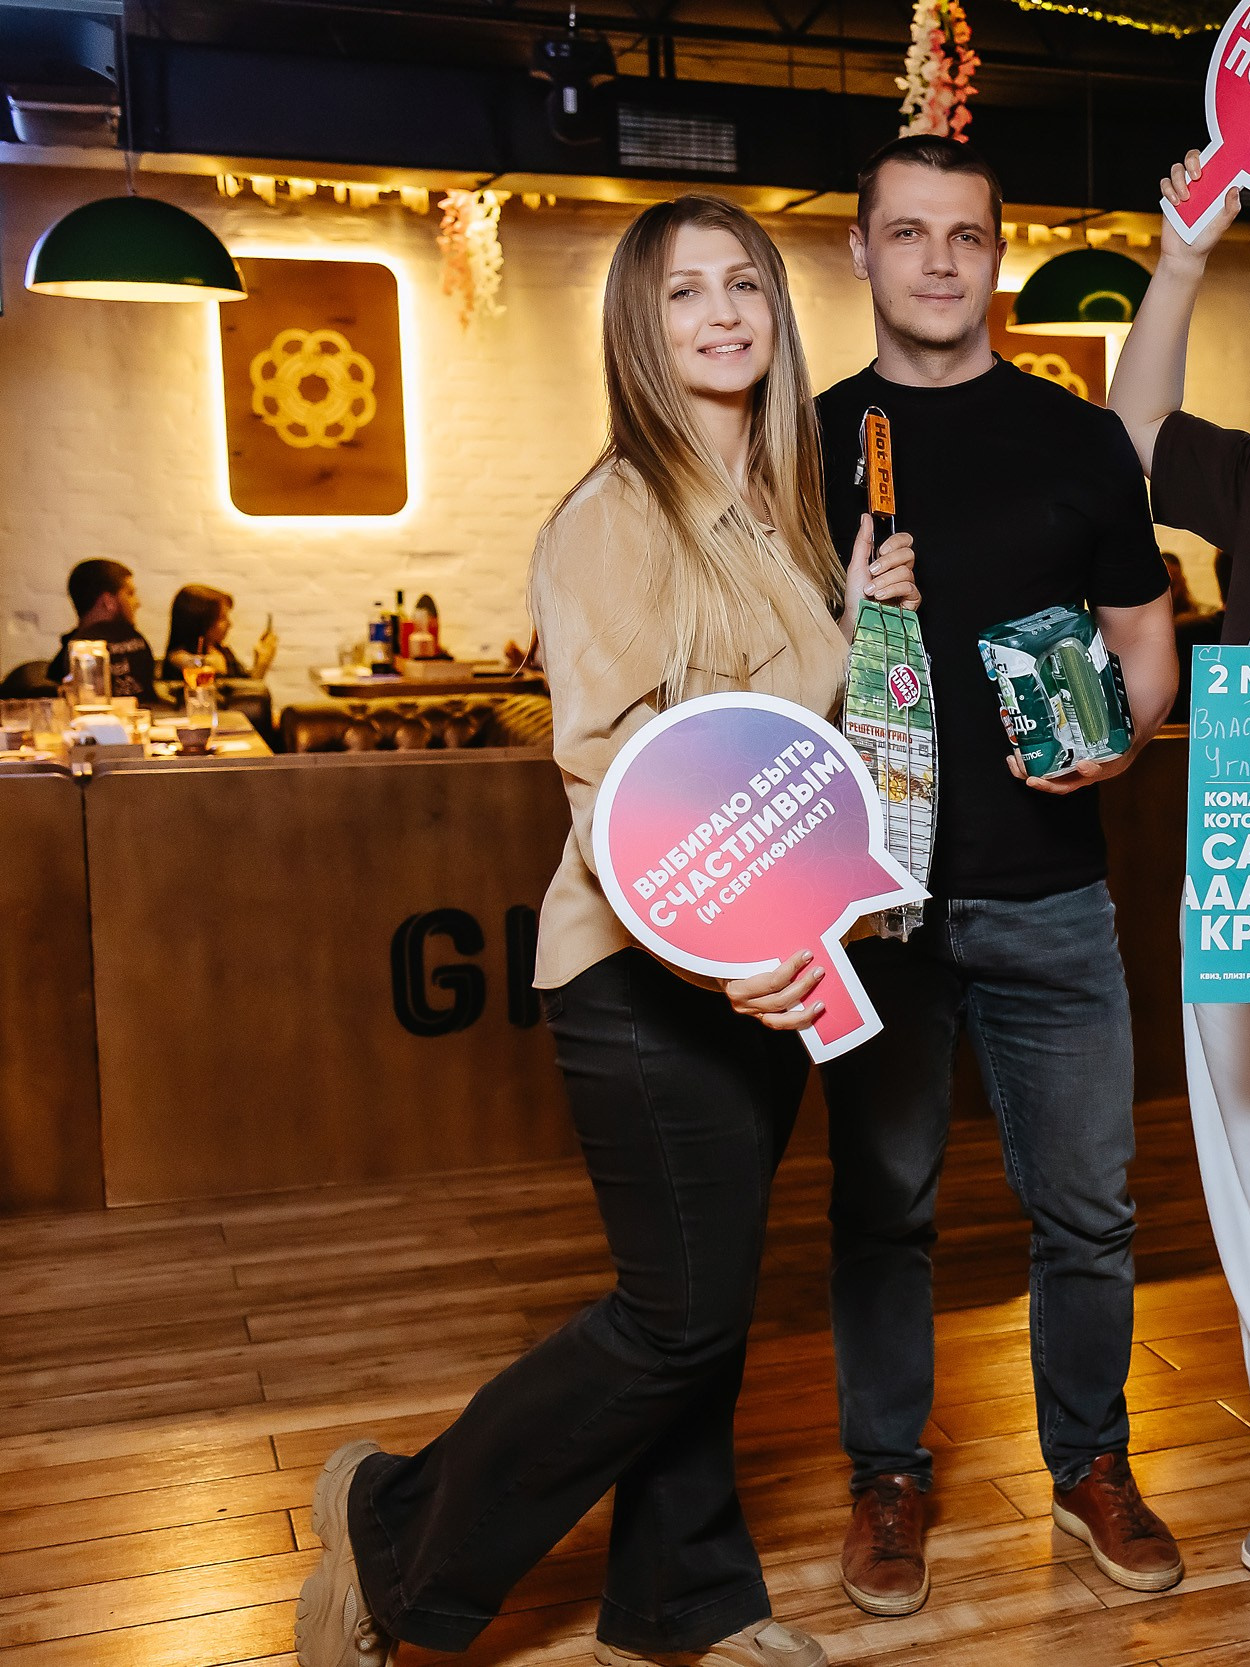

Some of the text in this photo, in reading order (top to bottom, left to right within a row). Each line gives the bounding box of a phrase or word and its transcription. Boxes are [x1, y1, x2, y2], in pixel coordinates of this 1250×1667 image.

[1208, 664, 1228, 694] 2
[632, 739, 815, 900] ВЫБИРАЮ БЫТЬ
[649, 750, 846, 928] СЧАСТЛИВЫМ
[696, 900, 722, 924] (И
[718, 798, 836, 904] СЕРТИФИКАТ)
[1200, 972, 1222, 980] КВИЗ,
[1222, 972, 1246, 980] ПЛИЗ!
